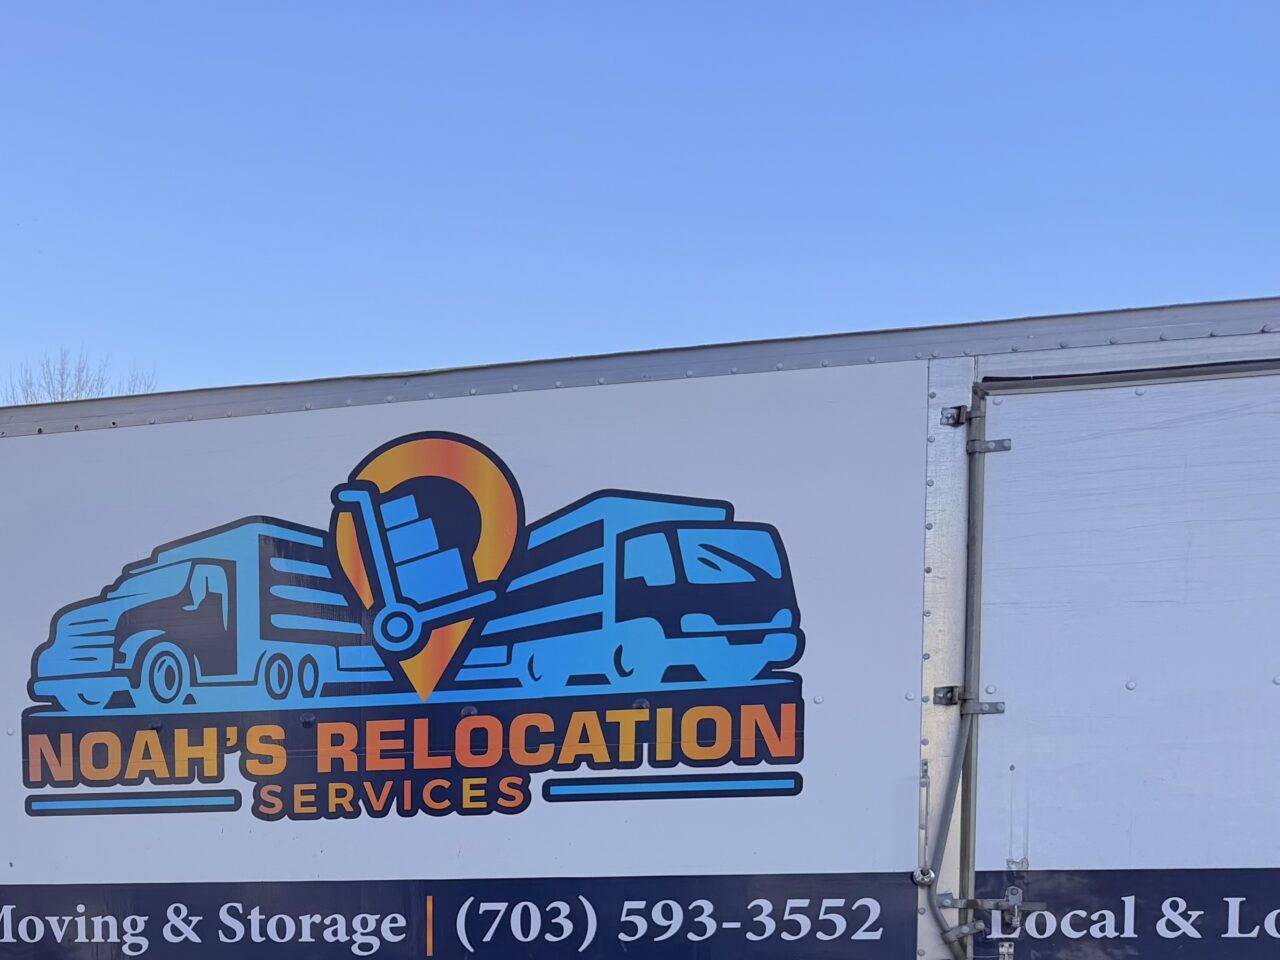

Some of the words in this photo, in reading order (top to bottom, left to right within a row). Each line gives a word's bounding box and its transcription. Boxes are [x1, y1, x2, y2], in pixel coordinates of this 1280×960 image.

[28, 724, 287, 782] NOAH'S
[317, 704, 796, 773] RELOCATION
[258, 776, 524, 815] SERVICES
[163, 903, 203, 943] &
[218, 903, 407, 956] Storage
[456, 896, 597, 953] (703)
[618, 898, 883, 941] 593-3552
[987, 895, 1138, 939] Local
[1156, 897, 1204, 939] &
